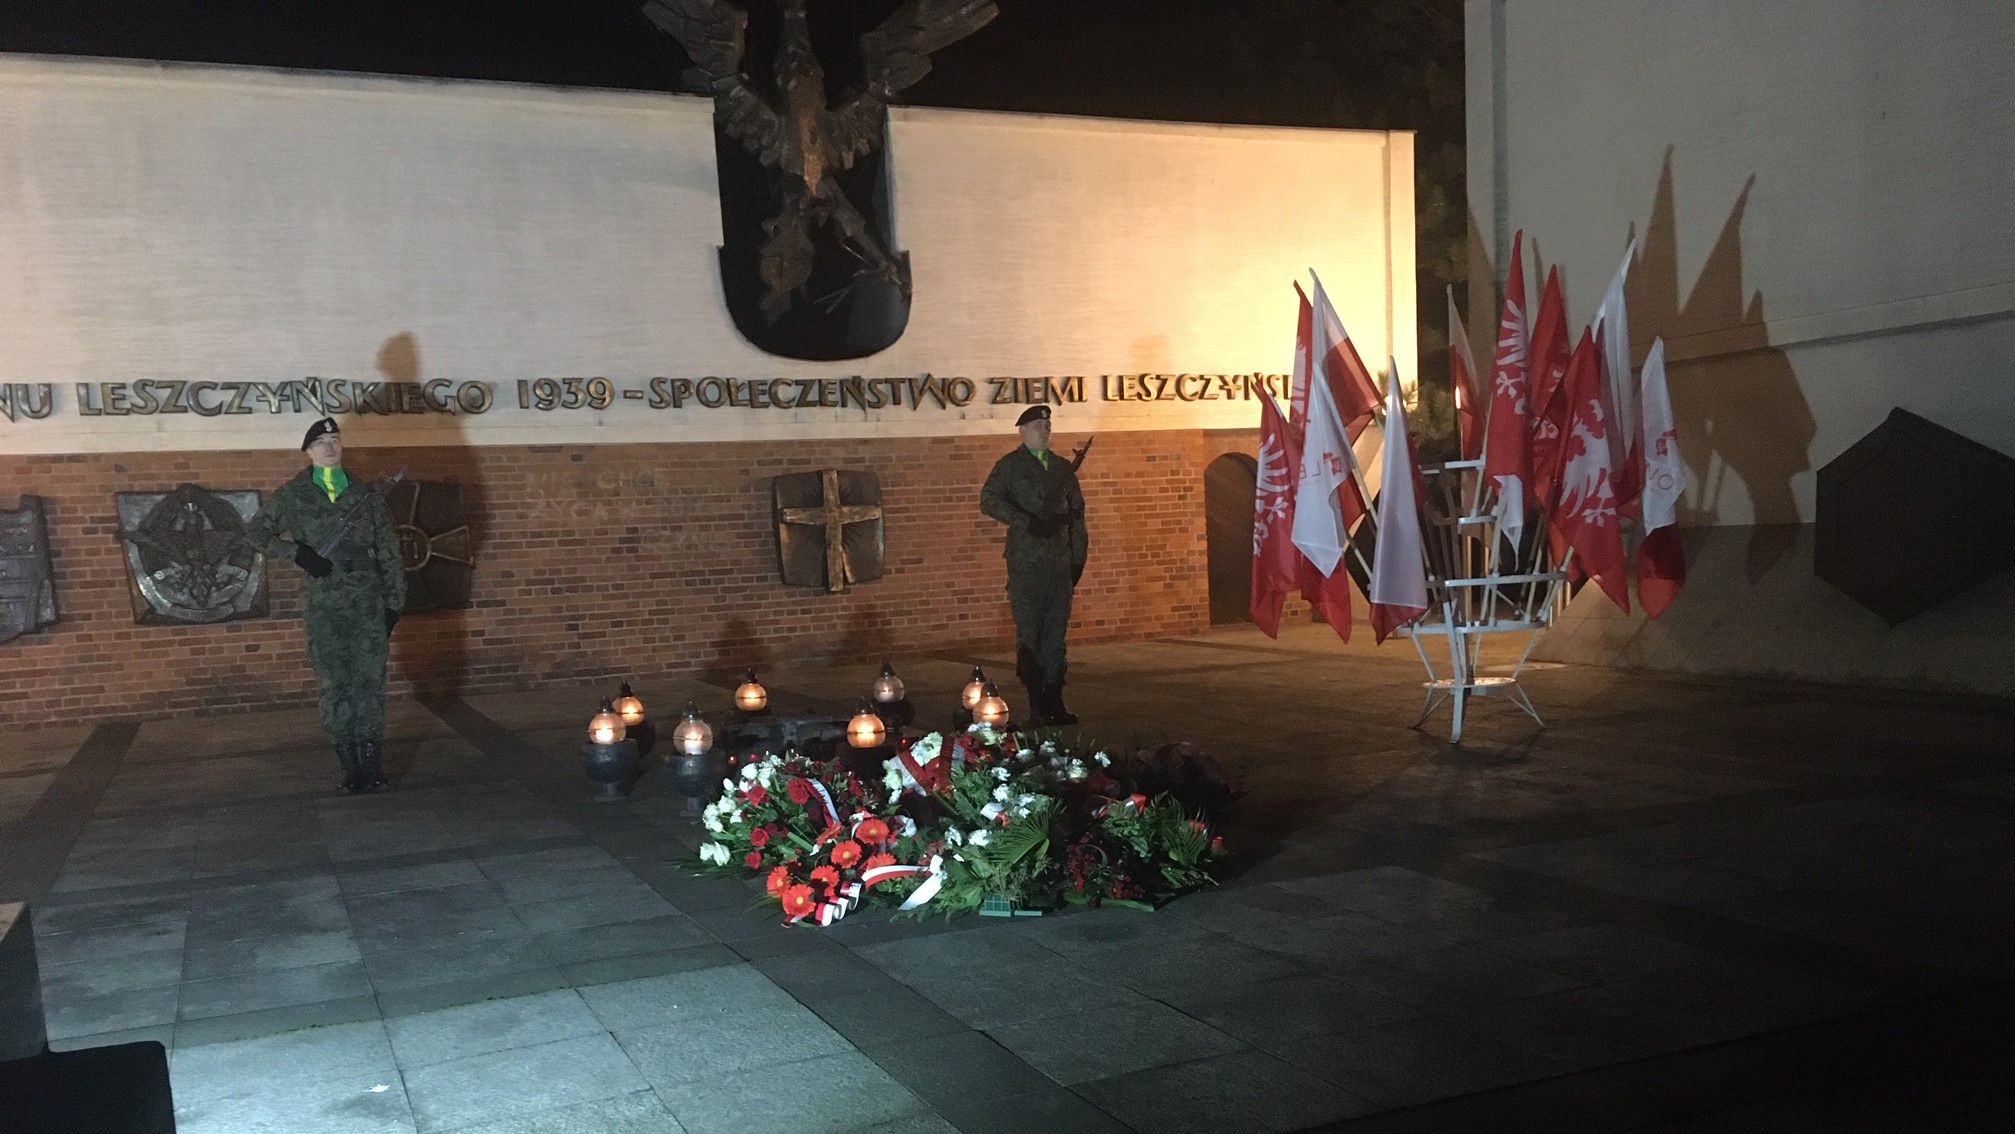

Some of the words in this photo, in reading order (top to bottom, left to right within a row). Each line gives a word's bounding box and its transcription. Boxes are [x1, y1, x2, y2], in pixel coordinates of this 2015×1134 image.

[76, 376, 494, 416] LESZCZYŃSKIEGO
[516, 376, 616, 411] 1939
[989, 375, 1088, 406] ZIEMI
